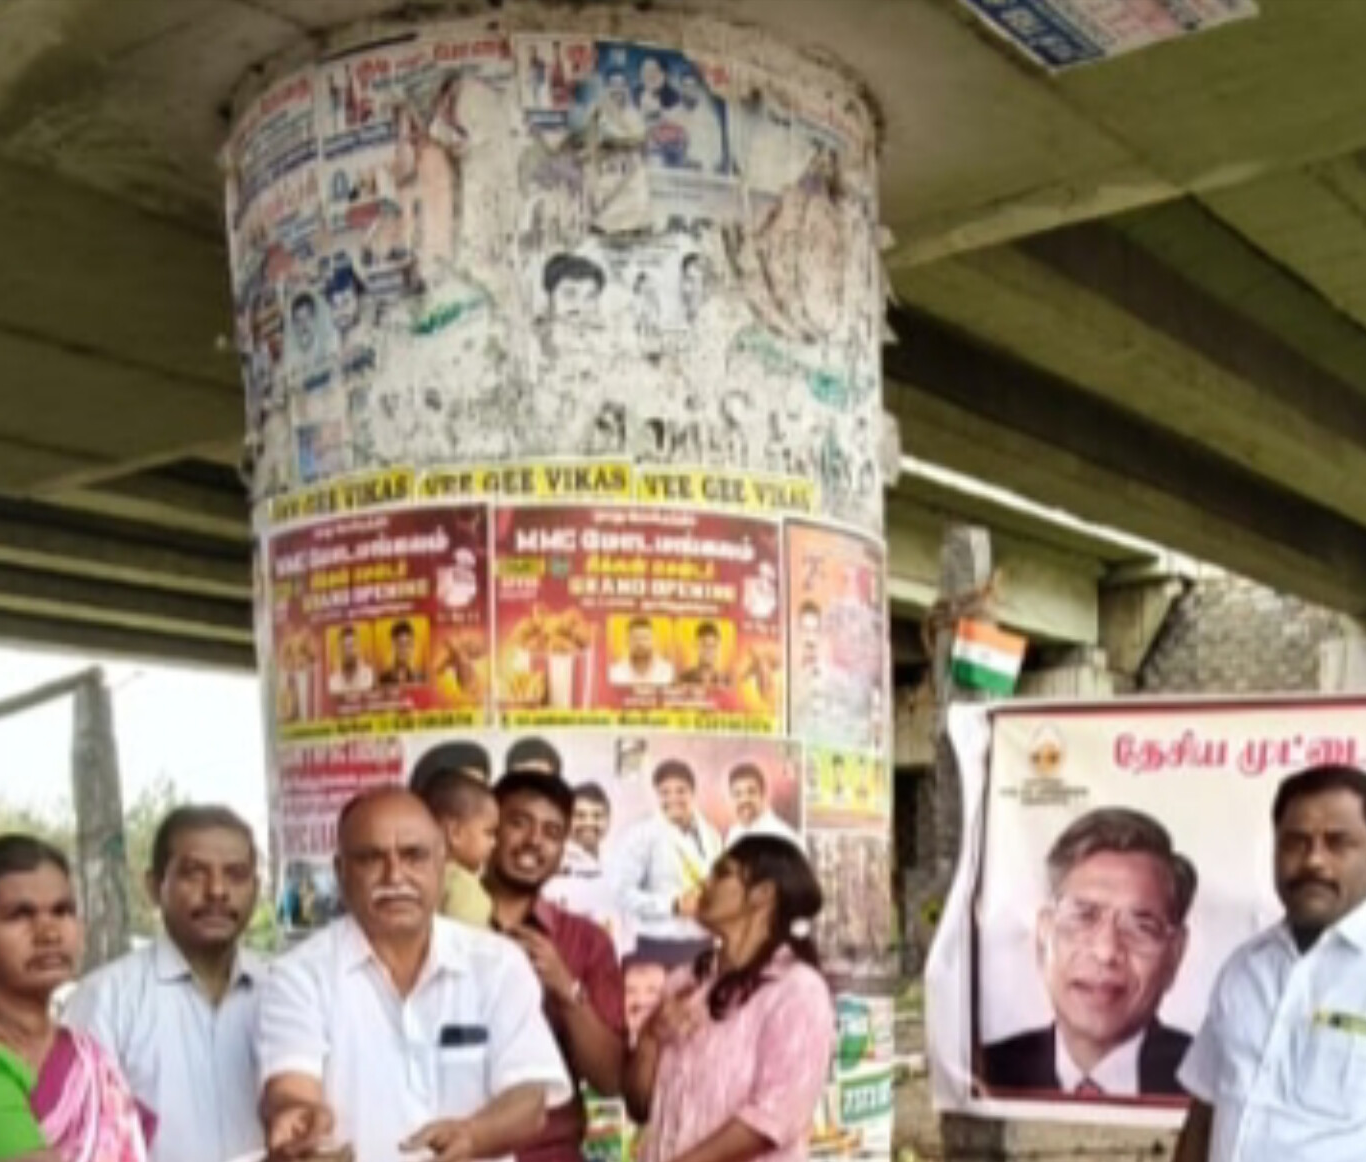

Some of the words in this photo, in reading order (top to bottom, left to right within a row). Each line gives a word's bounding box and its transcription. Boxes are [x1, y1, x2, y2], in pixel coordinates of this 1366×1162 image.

[421, 472, 474, 496] VEE
[482, 469, 534, 493] GEE
[545, 465, 627, 492] VIKAS
[641, 473, 693, 498] VEE
[700, 475, 745, 502] GEE
[568, 576, 647, 597] GRAND
[651, 578, 738, 601] OPENING
[1113, 729, 1229, 776] தேசிய
